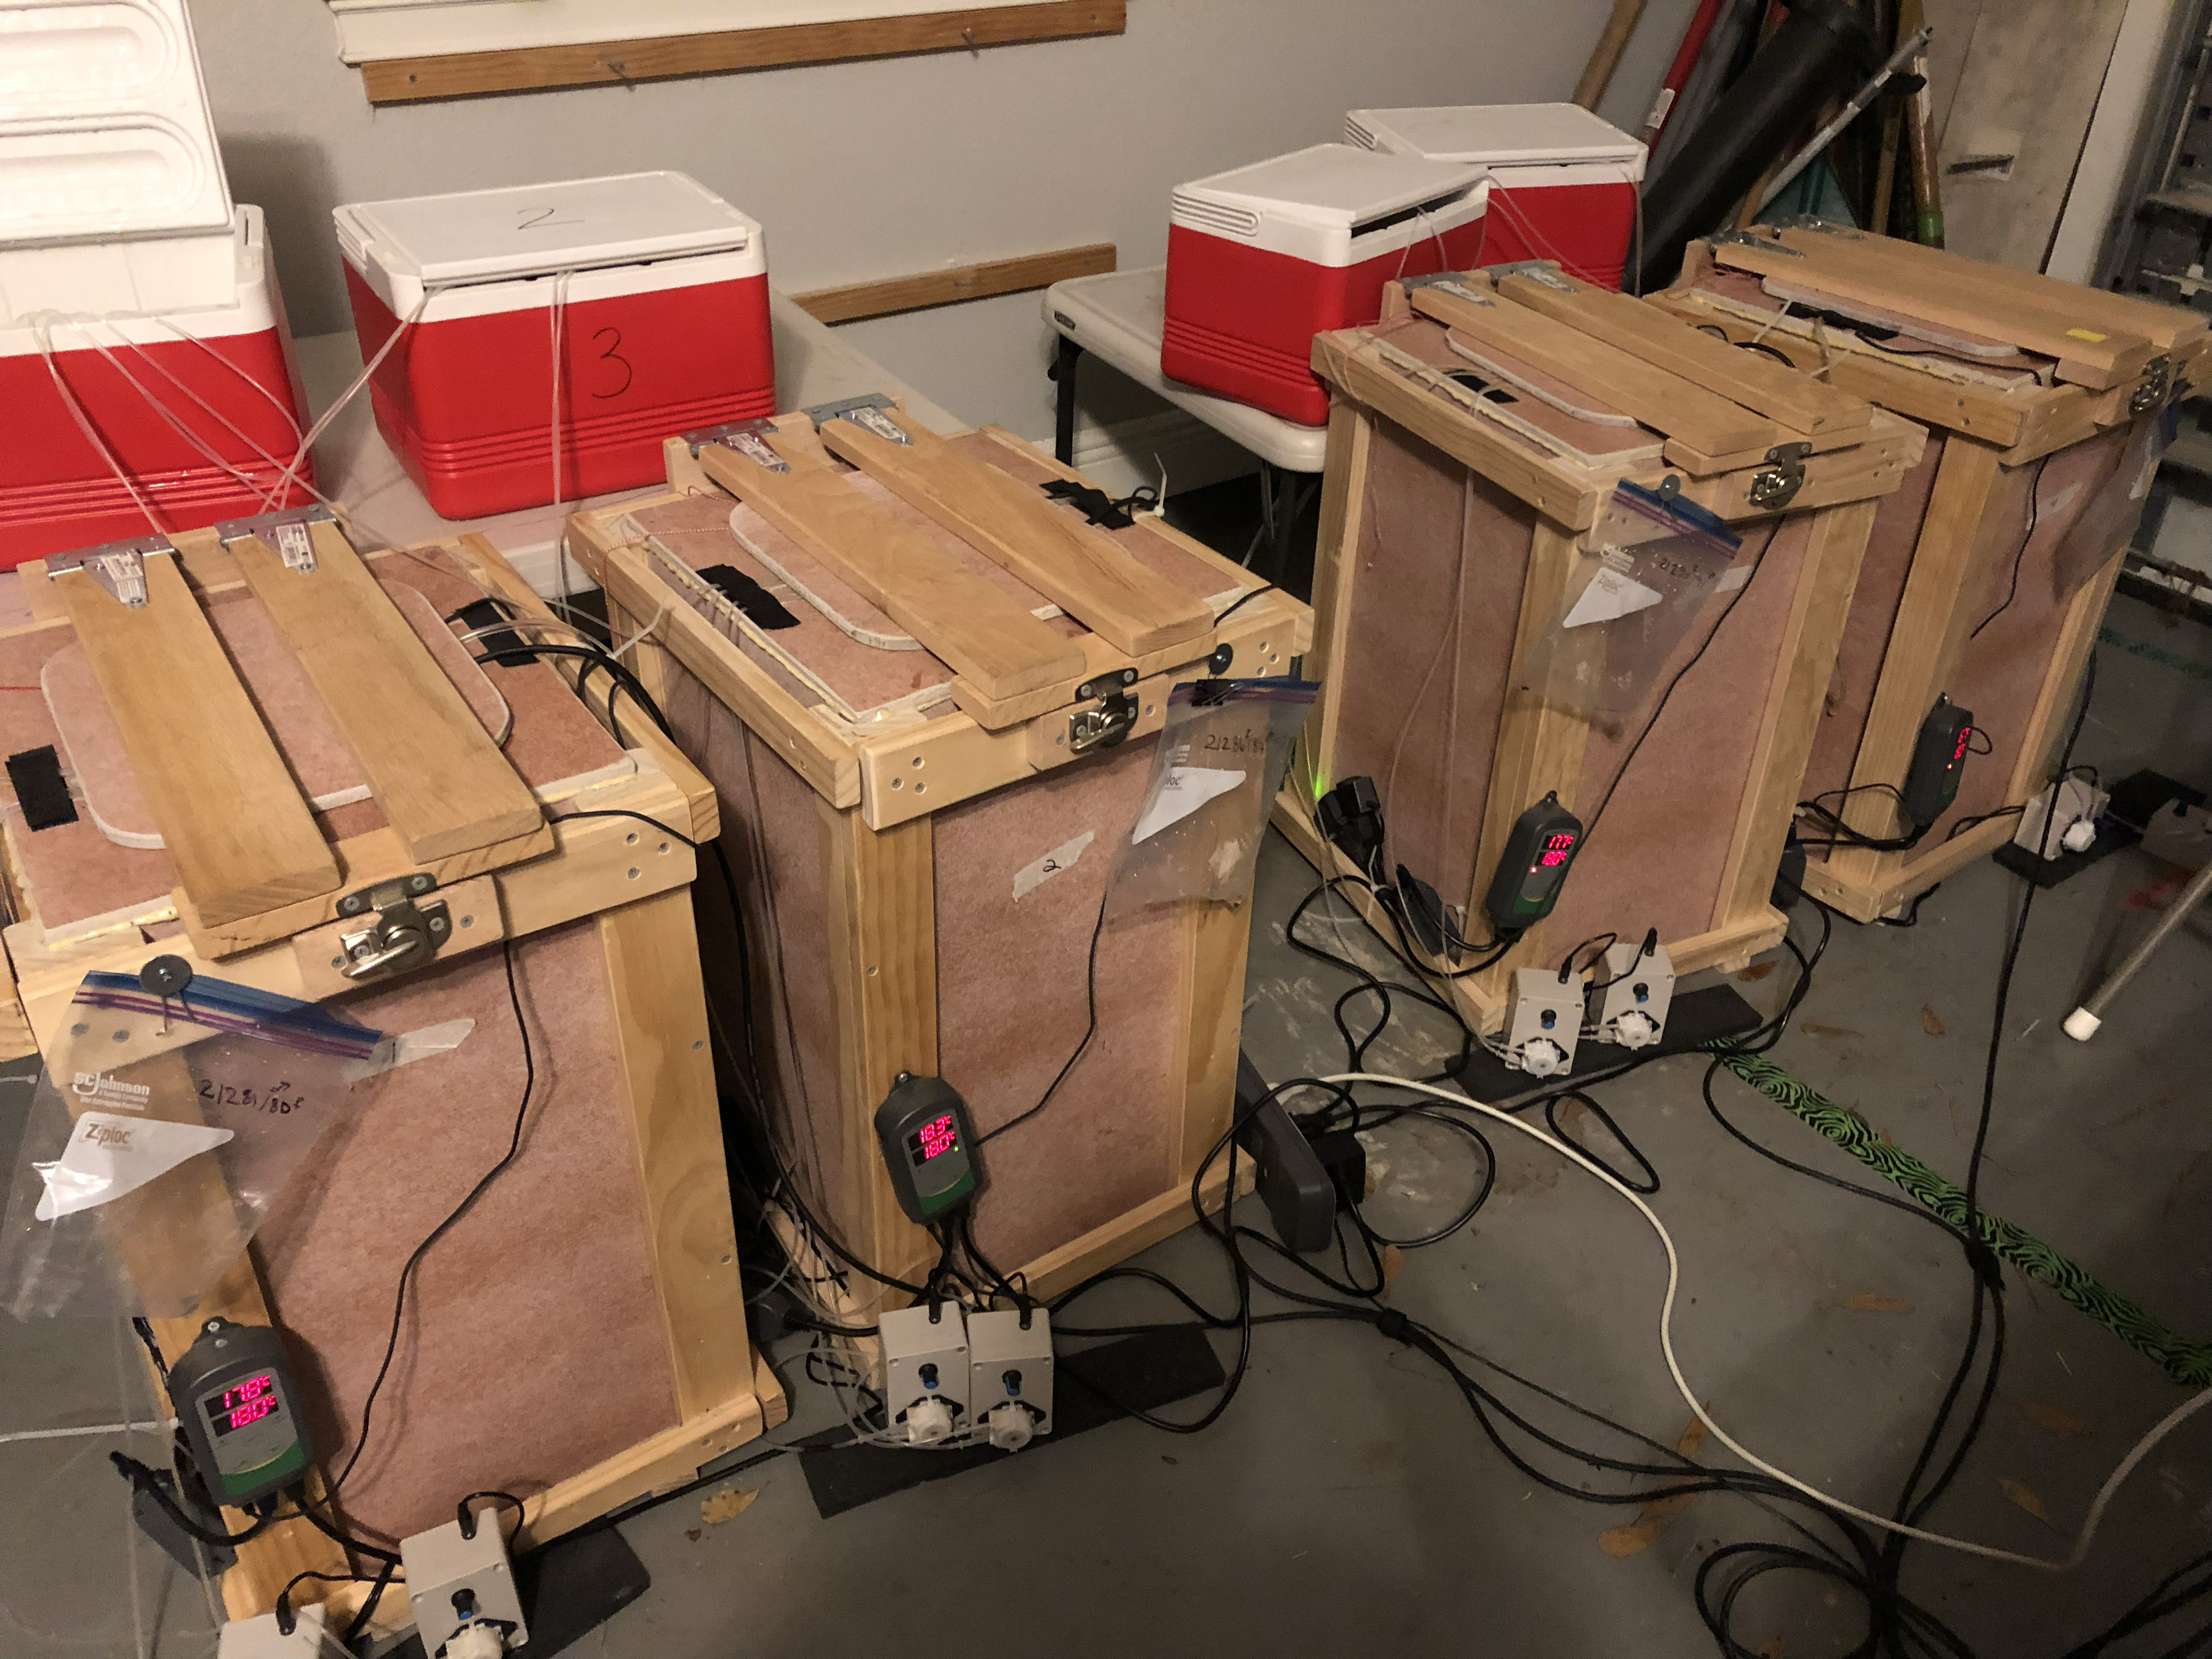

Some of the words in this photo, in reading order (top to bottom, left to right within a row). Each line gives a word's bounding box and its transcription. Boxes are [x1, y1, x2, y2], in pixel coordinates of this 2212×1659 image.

[518, 207, 585, 230] 2
[591, 327, 633, 399] 3
[1042, 859, 1062, 873] 2
[84, 1122, 131, 1146] Ziploc
